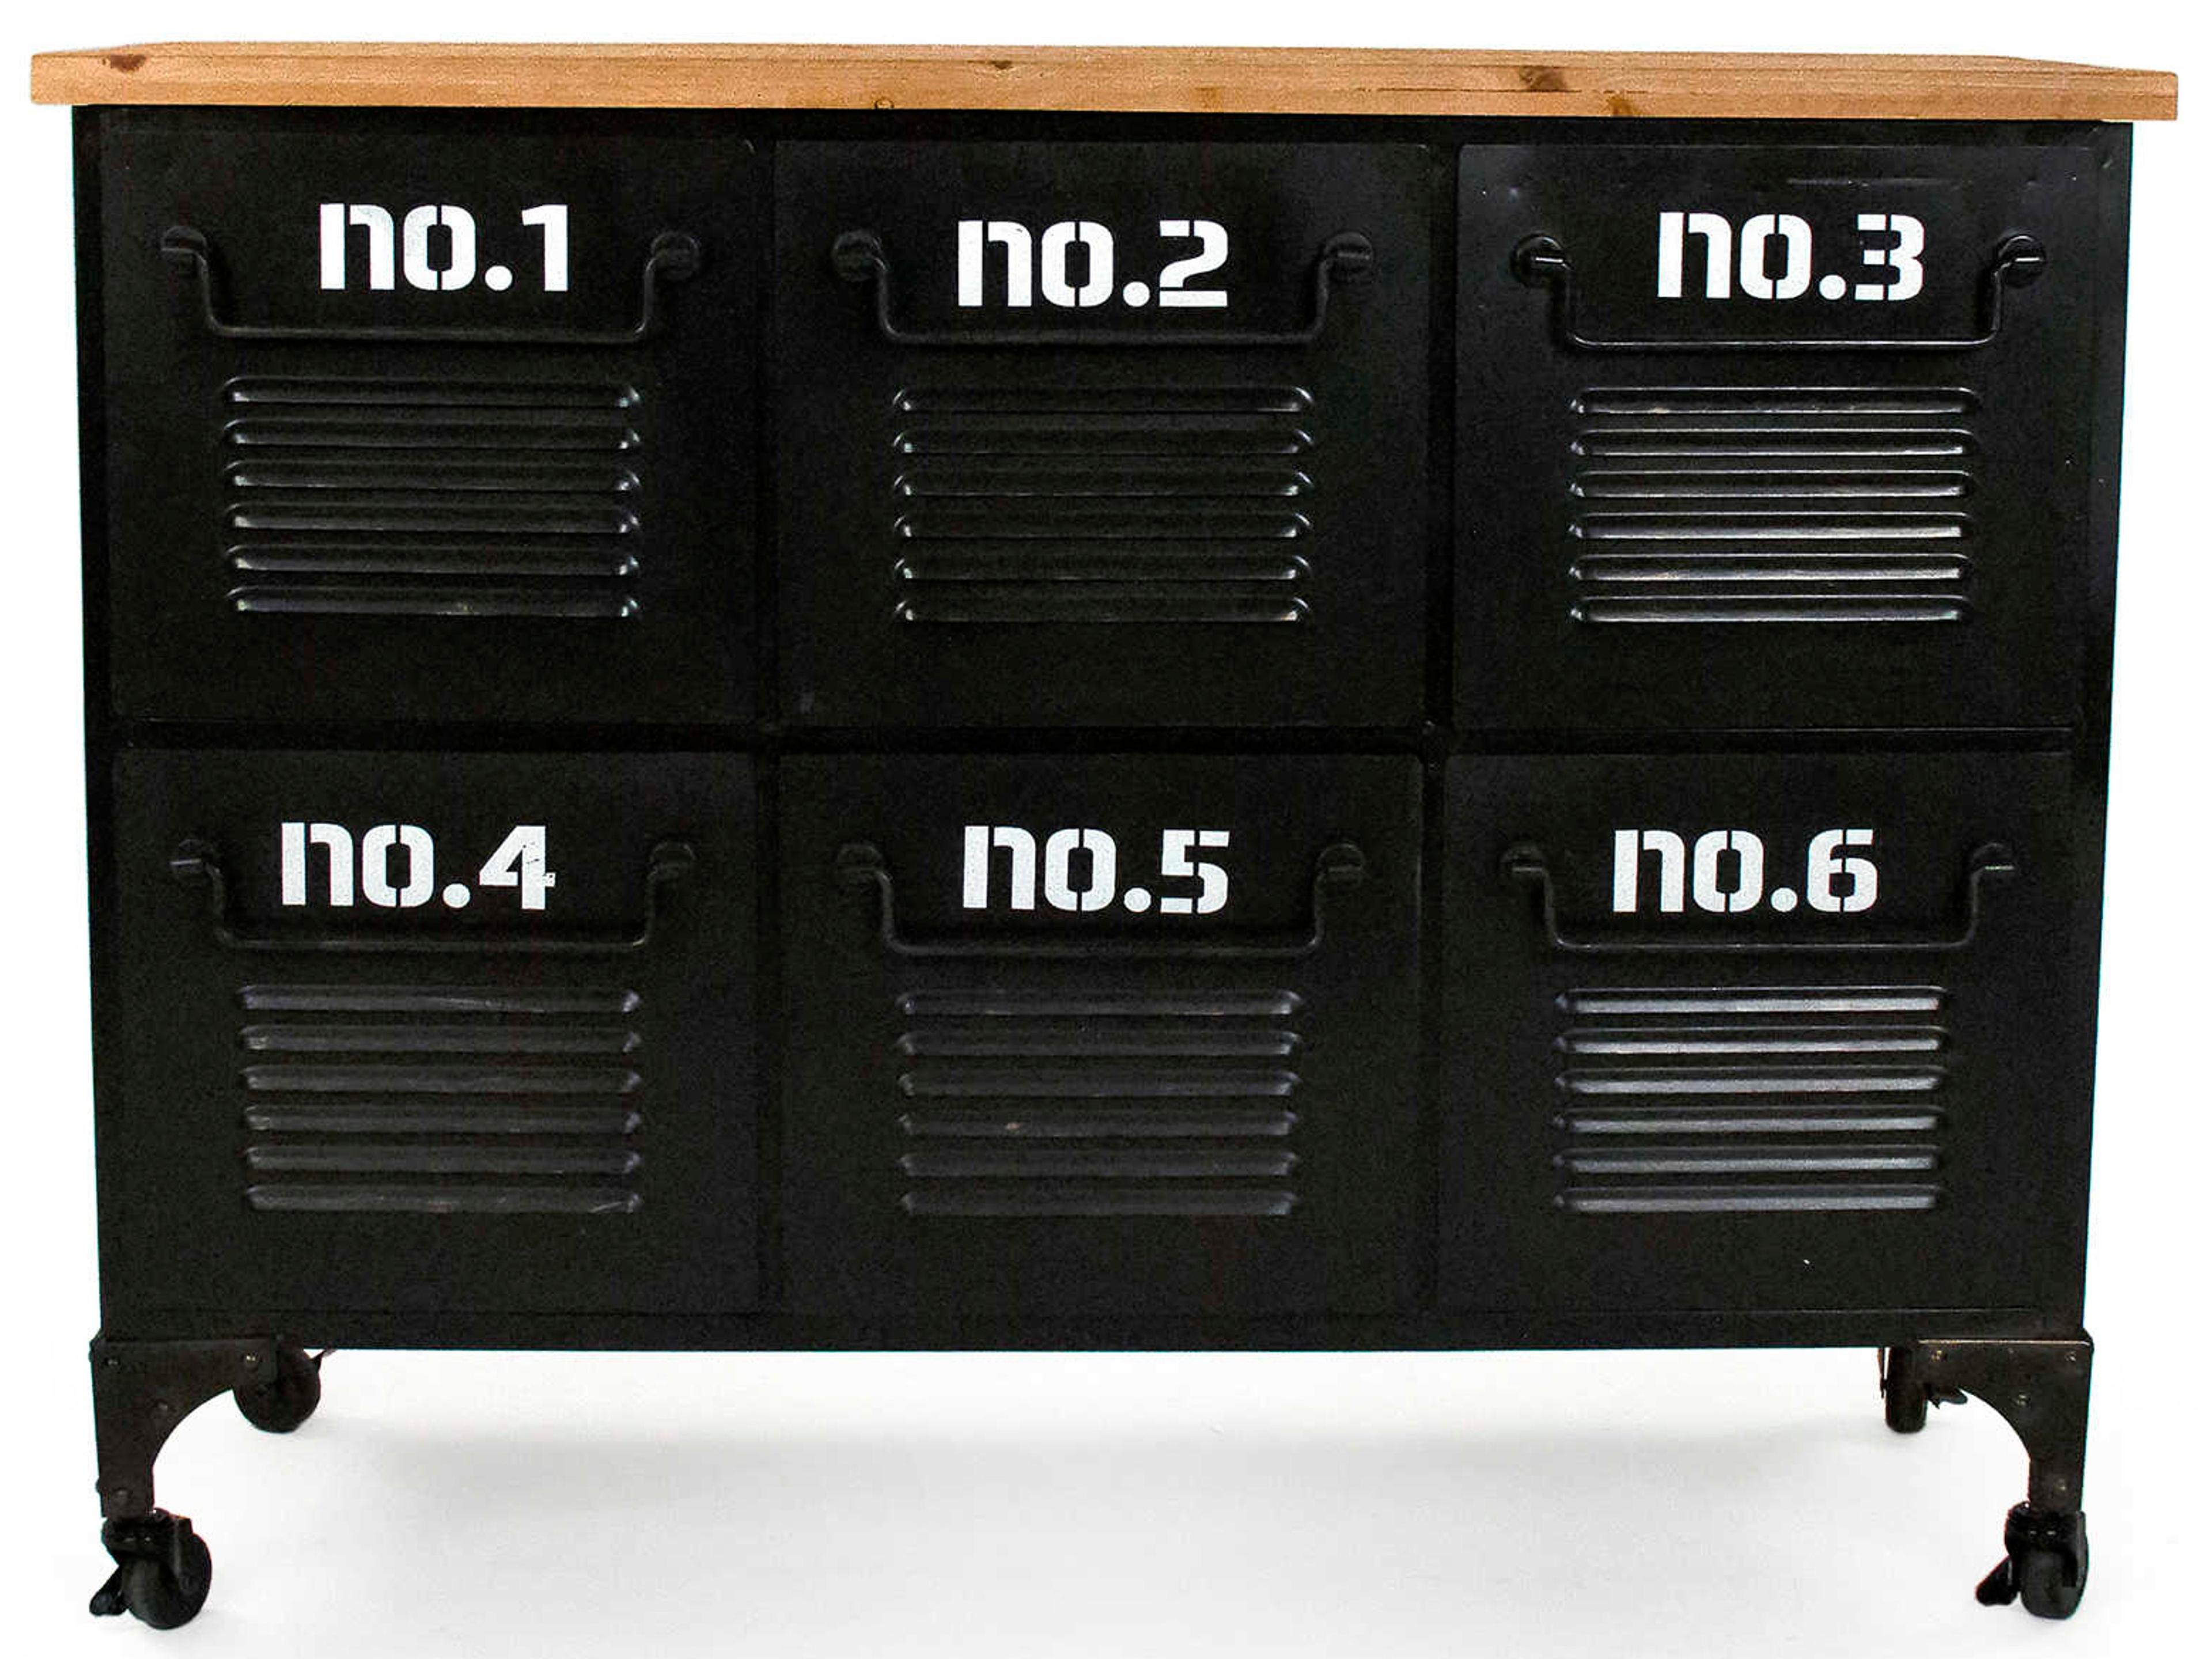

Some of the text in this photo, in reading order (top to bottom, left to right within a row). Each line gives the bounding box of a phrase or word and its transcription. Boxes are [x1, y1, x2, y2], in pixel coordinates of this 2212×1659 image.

[320, 203, 567, 291] no.1
[959, 221, 1228, 306] no.2
[1658, 213, 1924, 300] no.3
[282, 823, 555, 910] no.4
[963, 826, 1229, 913] no.5
[1613, 830, 1877, 912] no.6
